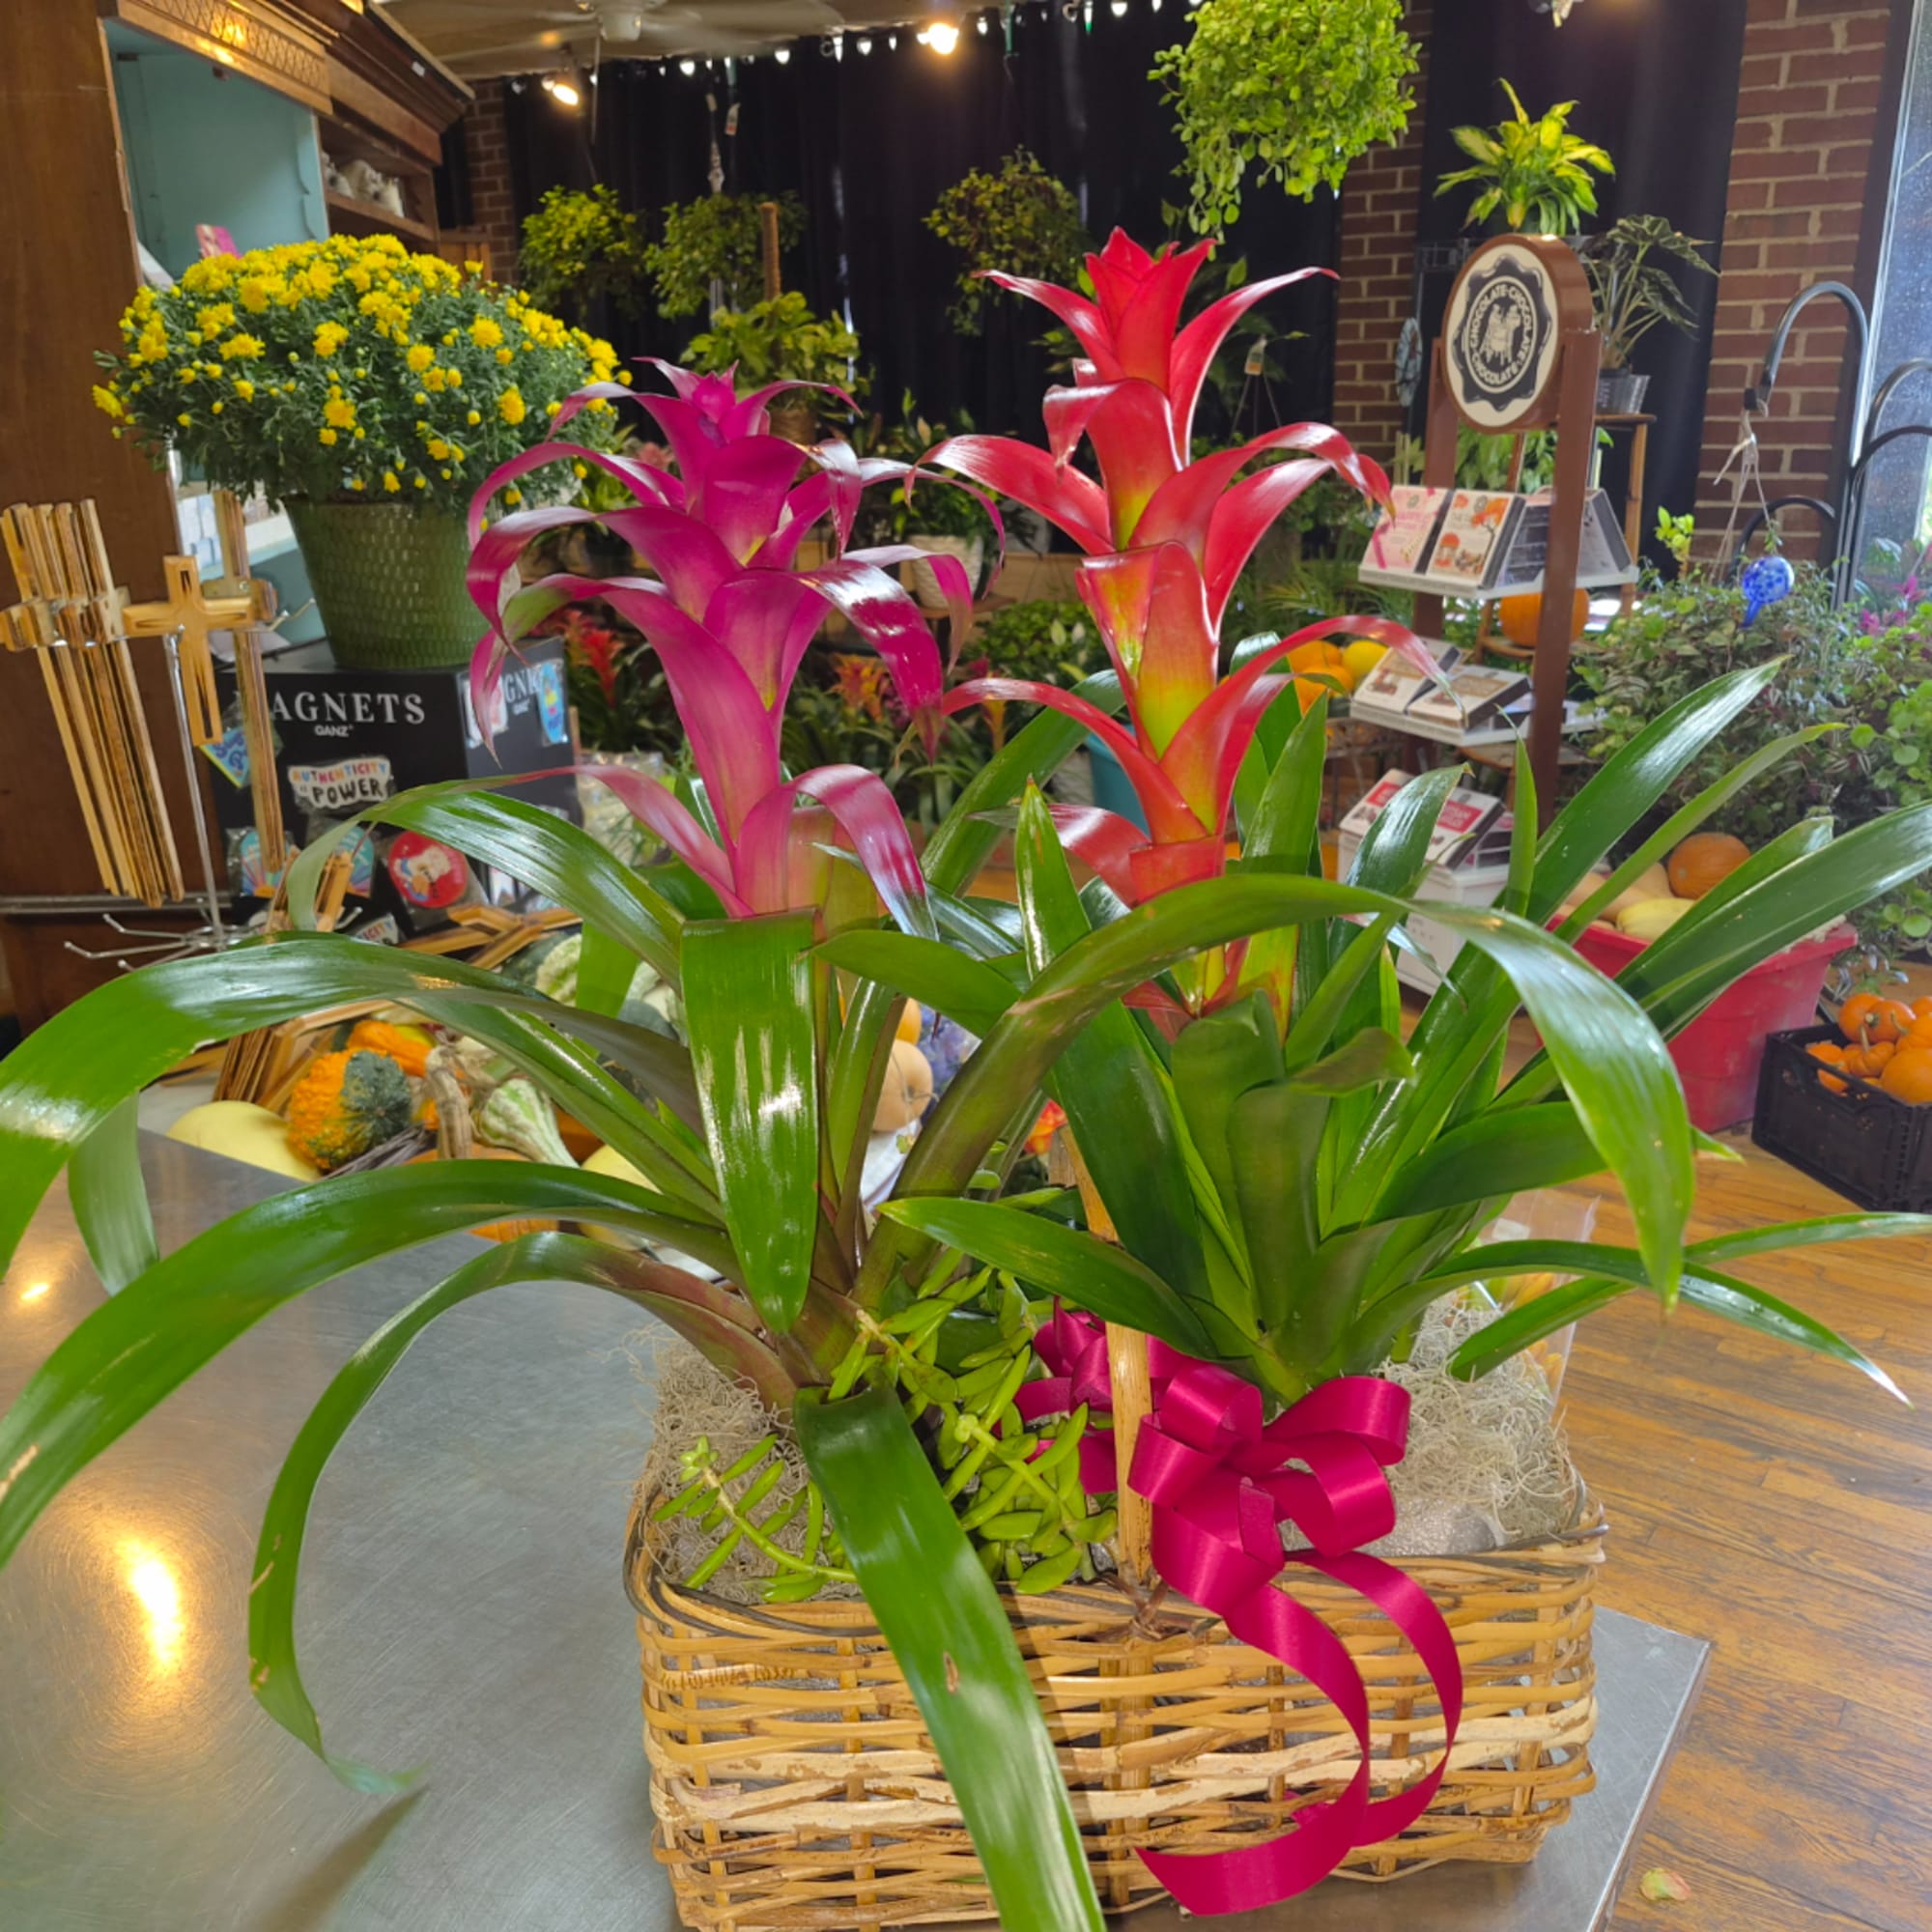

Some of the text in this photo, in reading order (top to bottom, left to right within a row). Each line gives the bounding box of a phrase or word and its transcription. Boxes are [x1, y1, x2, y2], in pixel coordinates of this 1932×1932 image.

[233, 690, 426, 724] AGNETS
[293, 761, 387, 784] AUTHENTICITY
[312, 778, 384, 804] POWER
